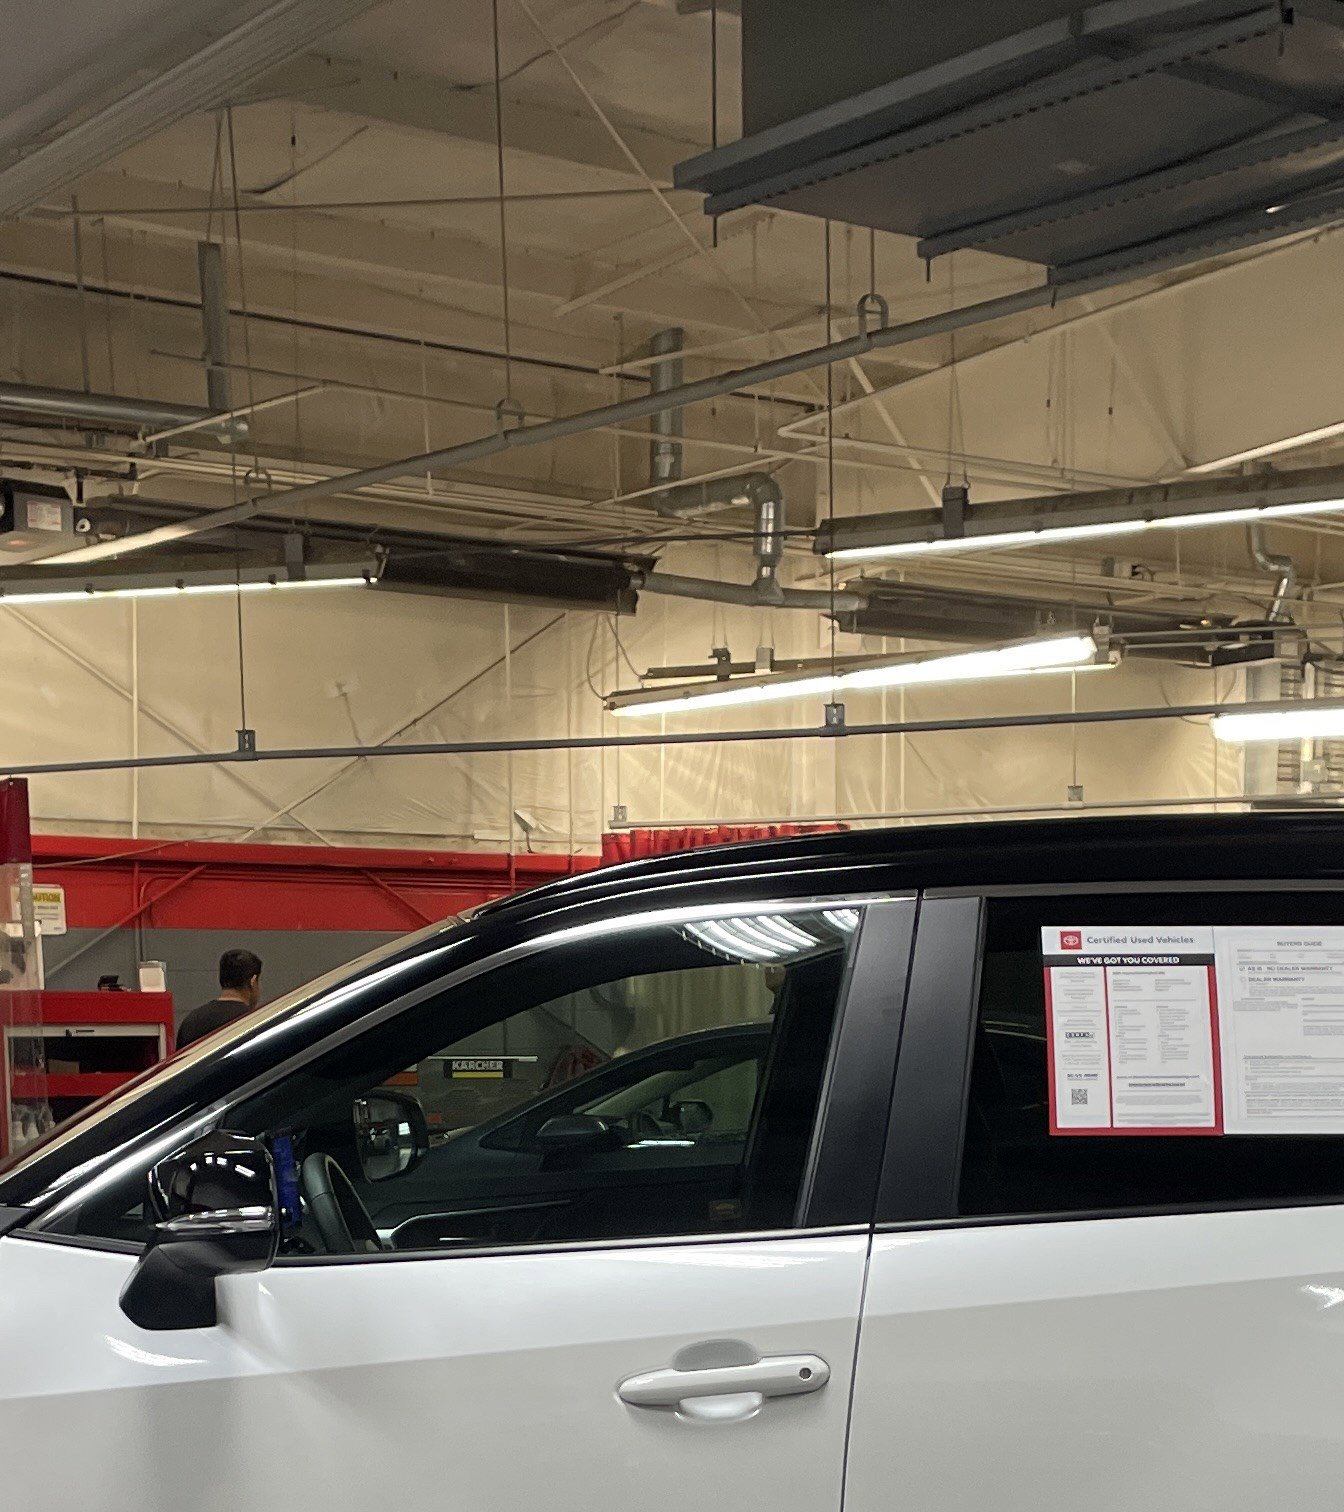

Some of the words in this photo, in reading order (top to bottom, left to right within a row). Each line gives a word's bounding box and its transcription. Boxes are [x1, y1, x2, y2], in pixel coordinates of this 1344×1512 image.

[1087, 936, 1127, 944] Certified
[1130, 936, 1154, 944] Used
[1156, 936, 1194, 944] Vehicles
[1077, 957, 1103, 965] WE'VE
[1142, 956, 1180, 964] COVERED
